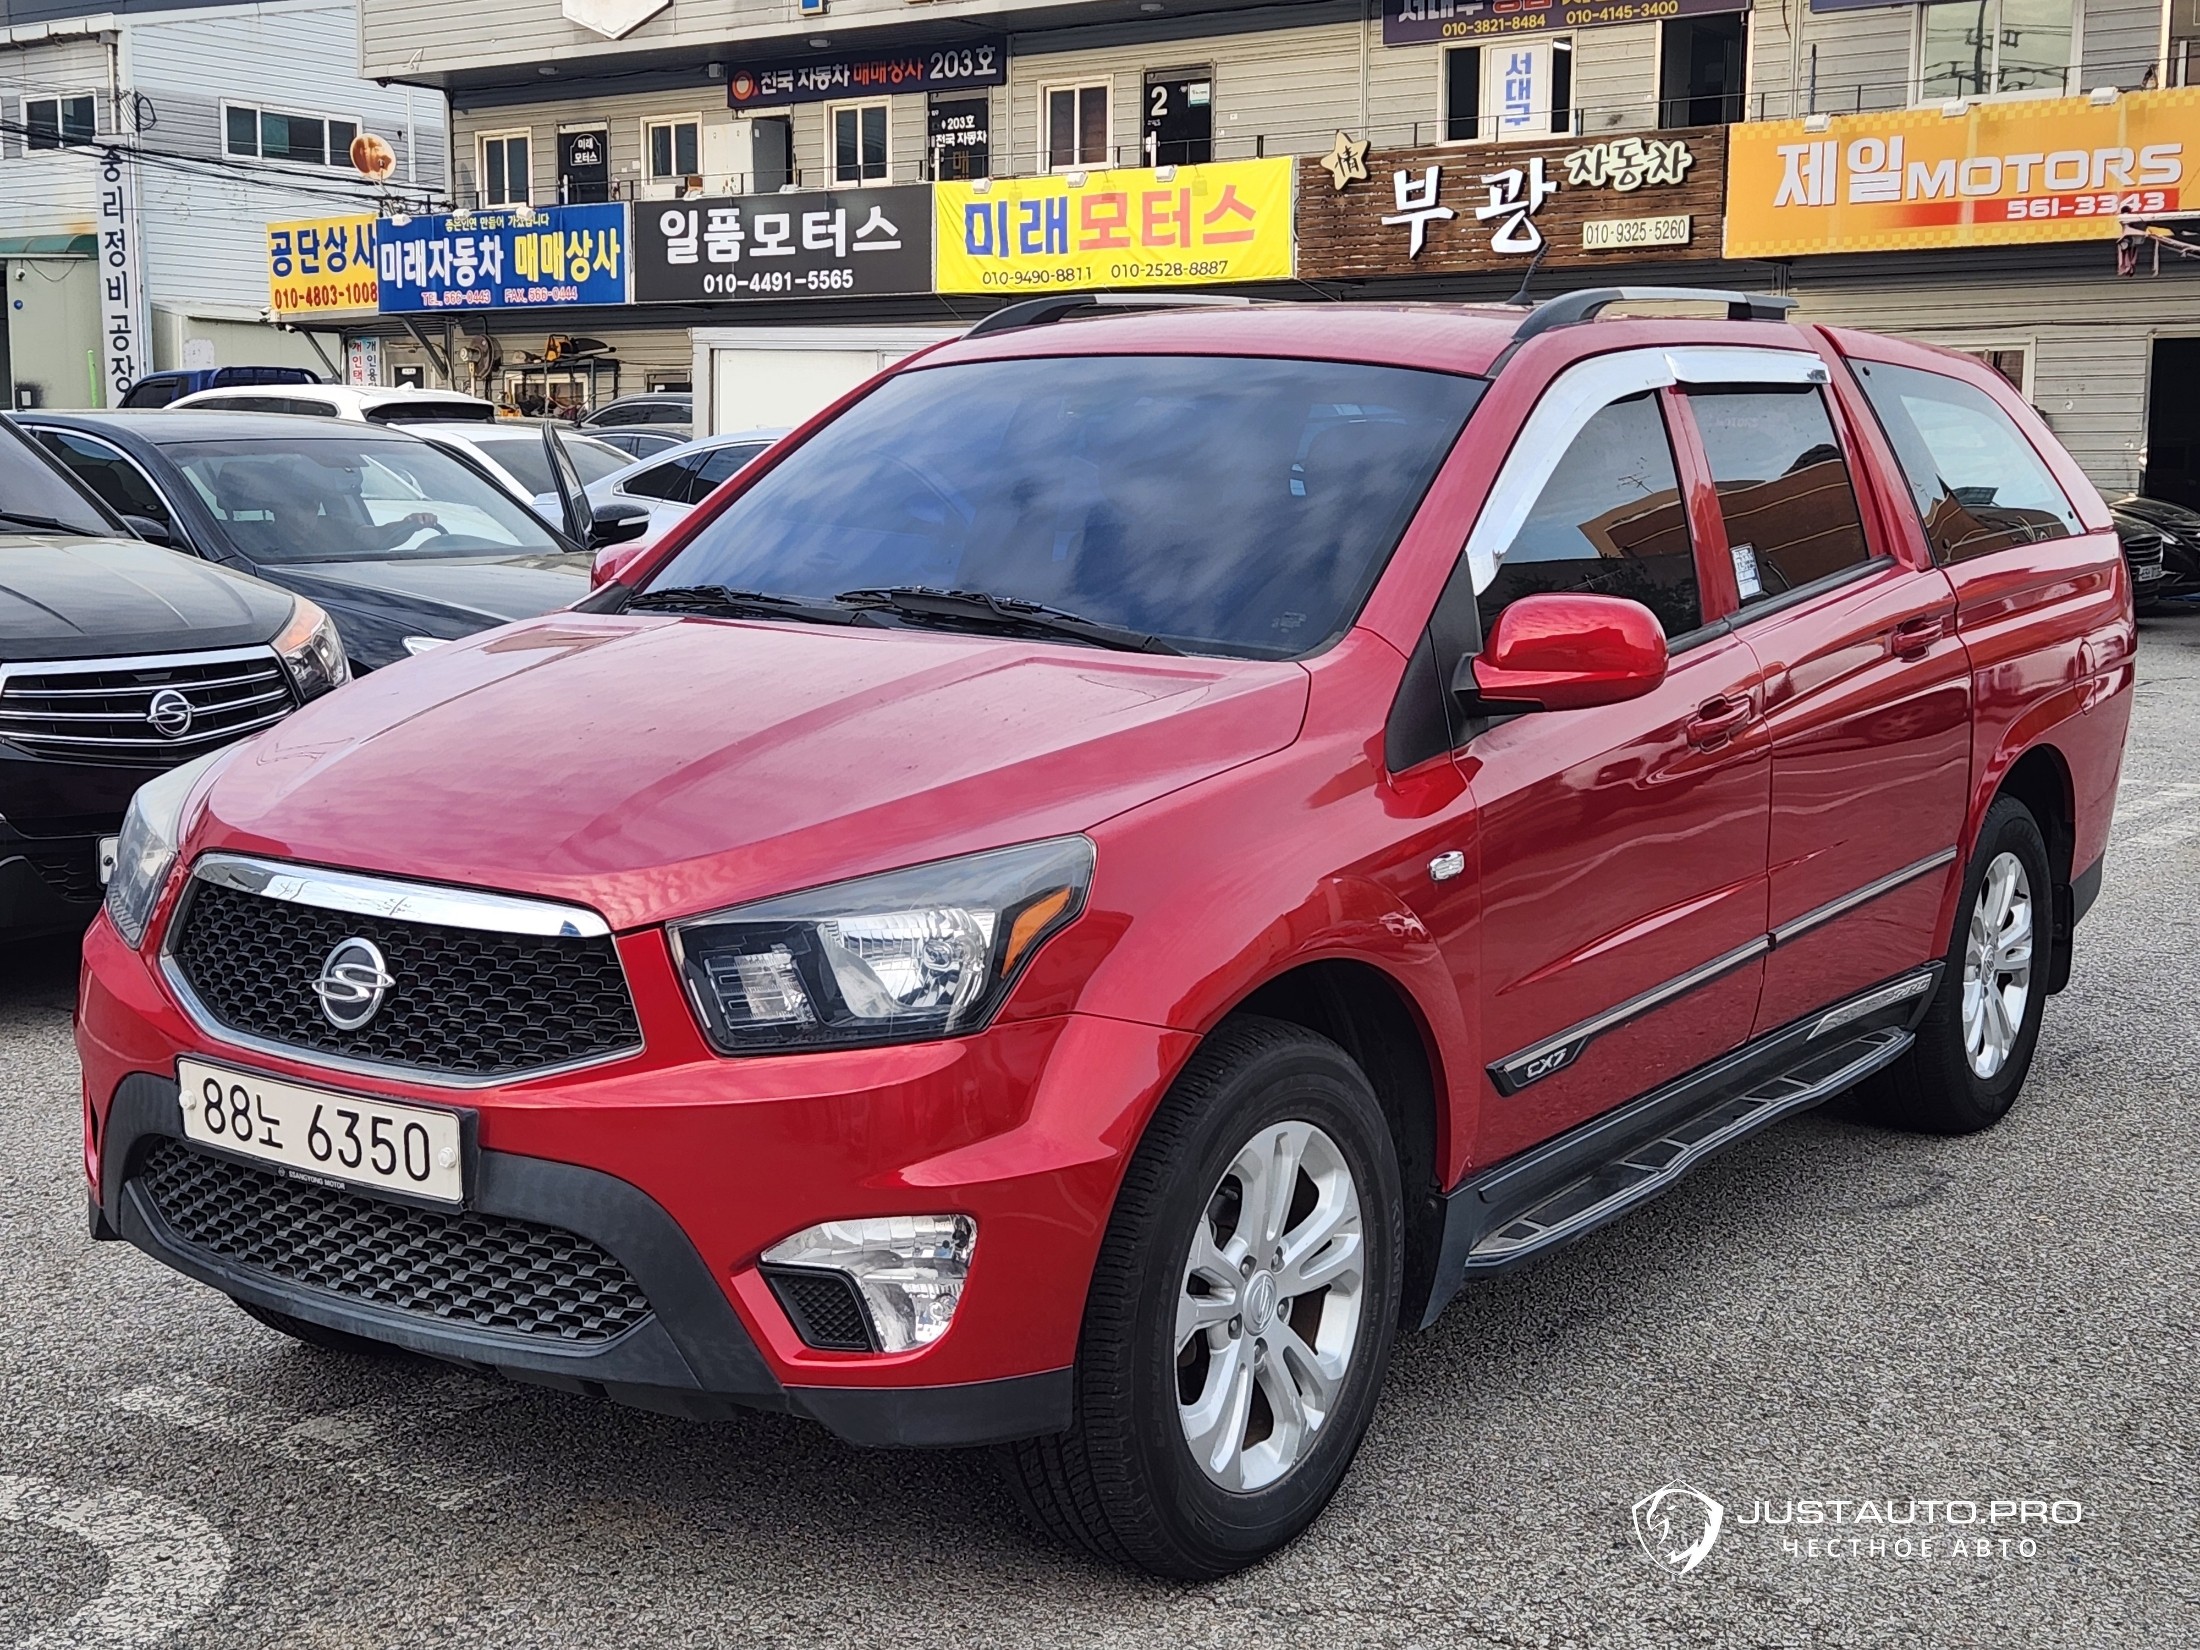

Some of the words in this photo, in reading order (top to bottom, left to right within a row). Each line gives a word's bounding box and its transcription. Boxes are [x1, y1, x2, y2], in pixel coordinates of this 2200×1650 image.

[1442, 13, 1546, 37] 010-3821-8484
[1566, 0, 1679, 24] 010-4145-3400
[760, 70, 795, 95] 전국
[797, 64, 850, 91] 자동차
[853, 57, 923, 86] 매매상사
[929, 45, 997, 80] 203호
[1151, 86, 1168, 117] 2
[1505, 52, 1532, 126] 서대구
[947, 115, 976, 131] 203호
[577, 137, 594, 150] 미래
[935, 133, 955, 148] 전국
[957, 130, 987, 146] 자동차
[574, 151, 598, 164] 모터스
[1566, 139, 1690, 188] 자동차
[2006, 190, 2166, 220] 561-3343
[659, 205, 902, 265] 일품모터스
[1586, 219, 1686, 245] 010-9325-5260
[271, 223, 377, 278] 공단상사
[380, 234, 504, 289] 미래자동차
[514, 228, 621, 283] 매매상사
[703, 269, 854, 294] 010-4491-5565
[982, 267, 1093, 286] 010-9490-8811
[1111, 260, 1229, 279] 010-2528-8887
[274, 281, 377, 310] 010-4803-1008
[1526, 1047, 1568, 1079] CX7
[203, 1077, 284, 1150] 88노
[308, 1104, 431, 1182] 6350
[288, 1170, 323, 1185] SSANGYONG
[324, 1178, 346, 1191] MOTOR
